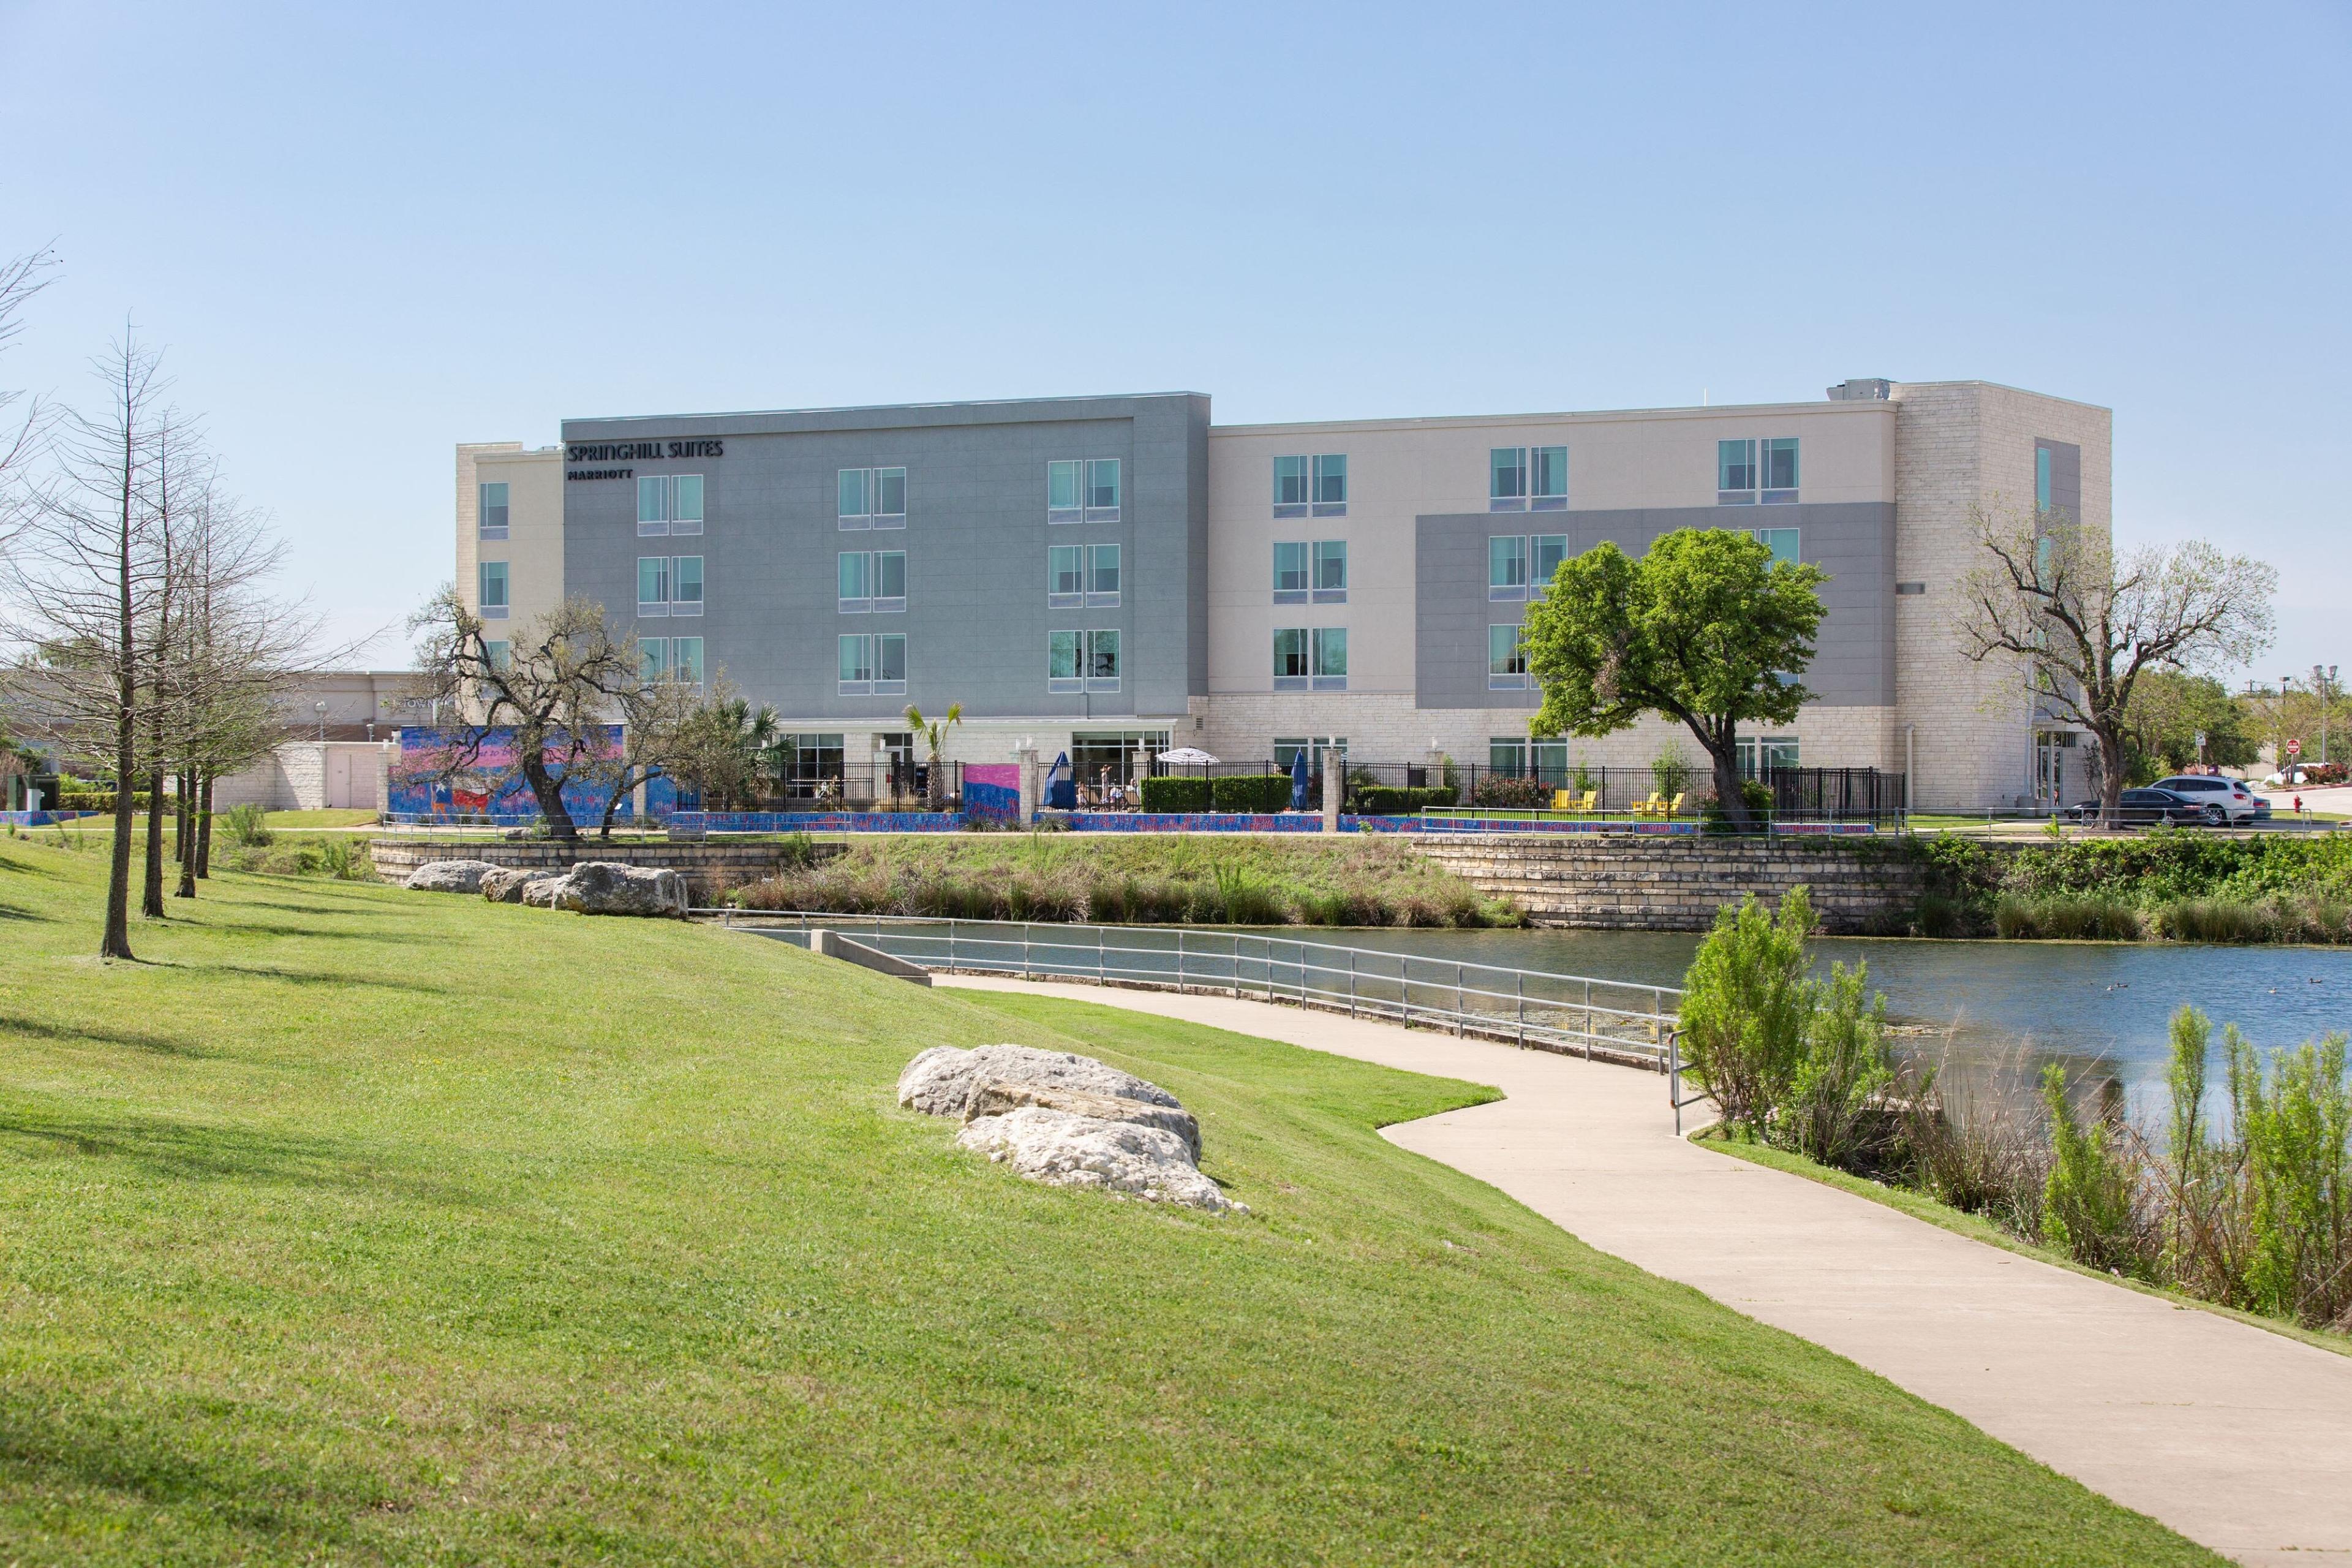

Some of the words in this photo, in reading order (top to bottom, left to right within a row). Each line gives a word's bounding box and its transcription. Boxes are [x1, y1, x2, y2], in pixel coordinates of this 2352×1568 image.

[568, 443, 664, 462] SPRINGHILL
[668, 440, 723, 458] SUITES
[568, 469, 633, 480] MARRIOTT
